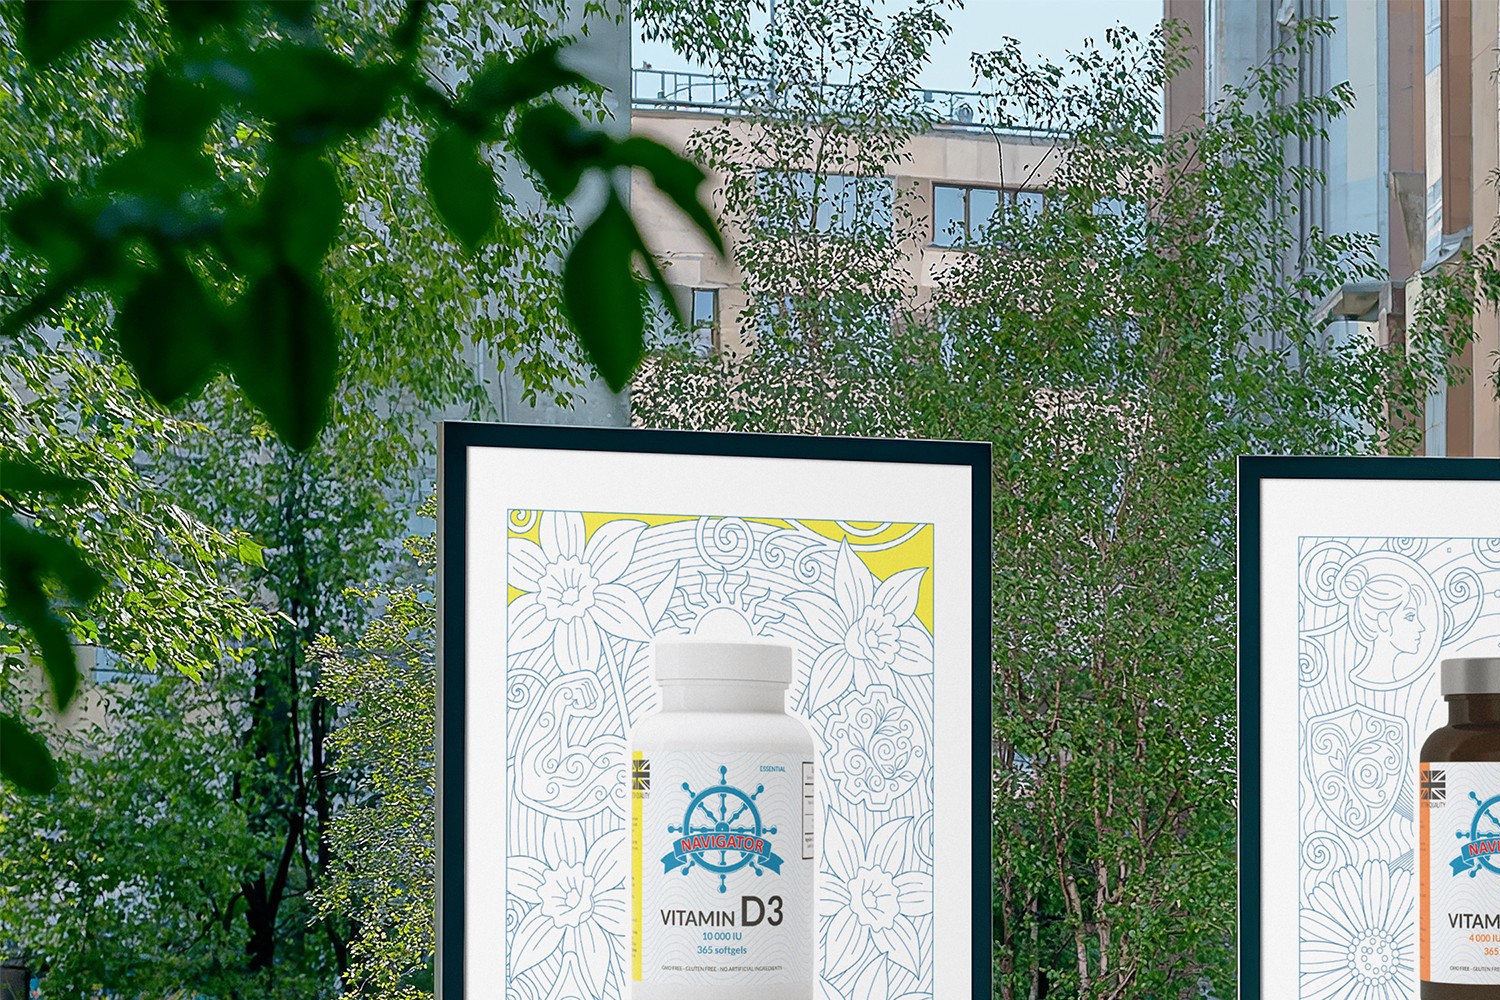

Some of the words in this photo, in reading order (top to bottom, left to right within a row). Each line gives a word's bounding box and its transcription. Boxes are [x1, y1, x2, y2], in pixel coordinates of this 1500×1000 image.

[759, 765, 786, 773] ESSENTIAL
[681, 835, 764, 853] NAVIGATOR
[660, 909, 735, 927] VITAMIN
[741, 895, 784, 927] D3
[703, 932, 713, 941] 10
[714, 932, 731, 941] 000
[732, 932, 742, 941] IU
[1469, 934, 1475, 943] 4
[1475, 934, 1490, 943] 000
[697, 946, 713, 954] 365
[714, 945, 747, 956] softgels
[1484, 947, 1499, 956] 365
